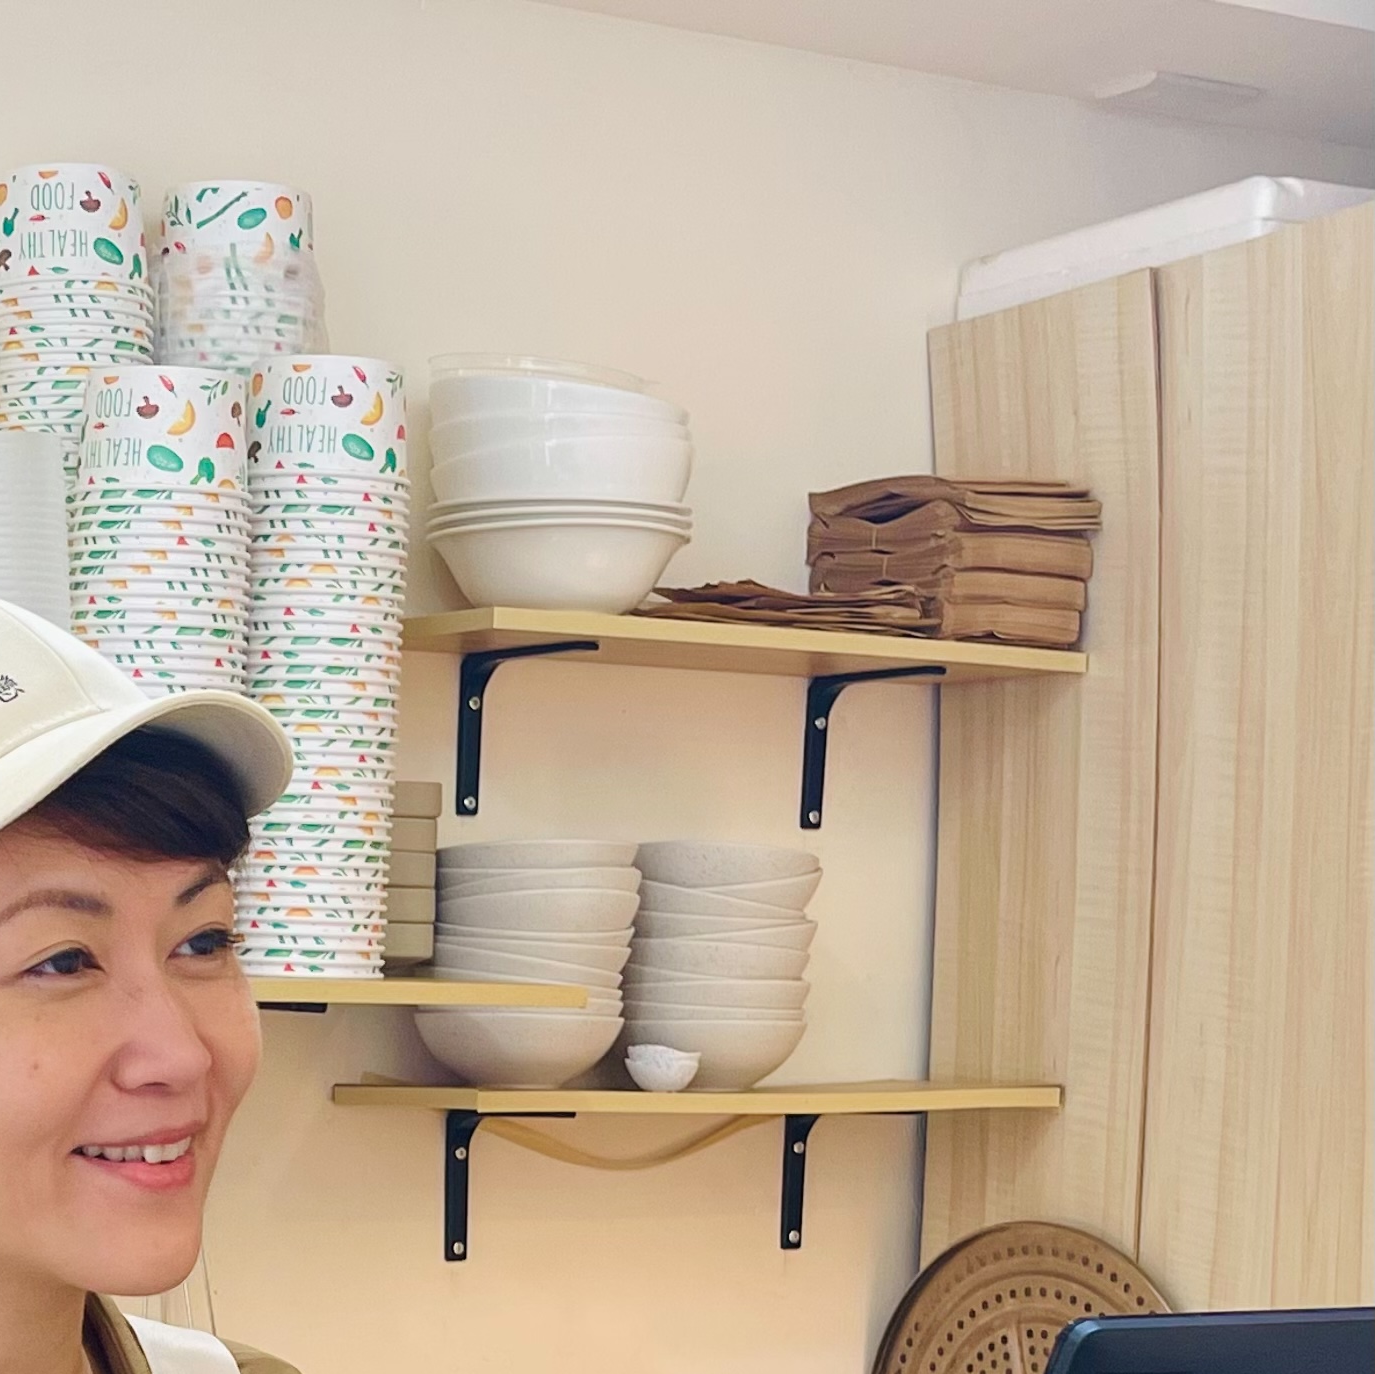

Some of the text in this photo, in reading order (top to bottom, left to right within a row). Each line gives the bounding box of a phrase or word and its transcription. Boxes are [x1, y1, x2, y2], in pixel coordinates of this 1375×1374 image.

[30, 181, 75, 211] FOOD
[17, 229, 88, 260] HEALTHY
[95, 388, 133, 418] FOOD
[283, 376, 327, 405] FOOD
[267, 424, 337, 455] HEALTHY
